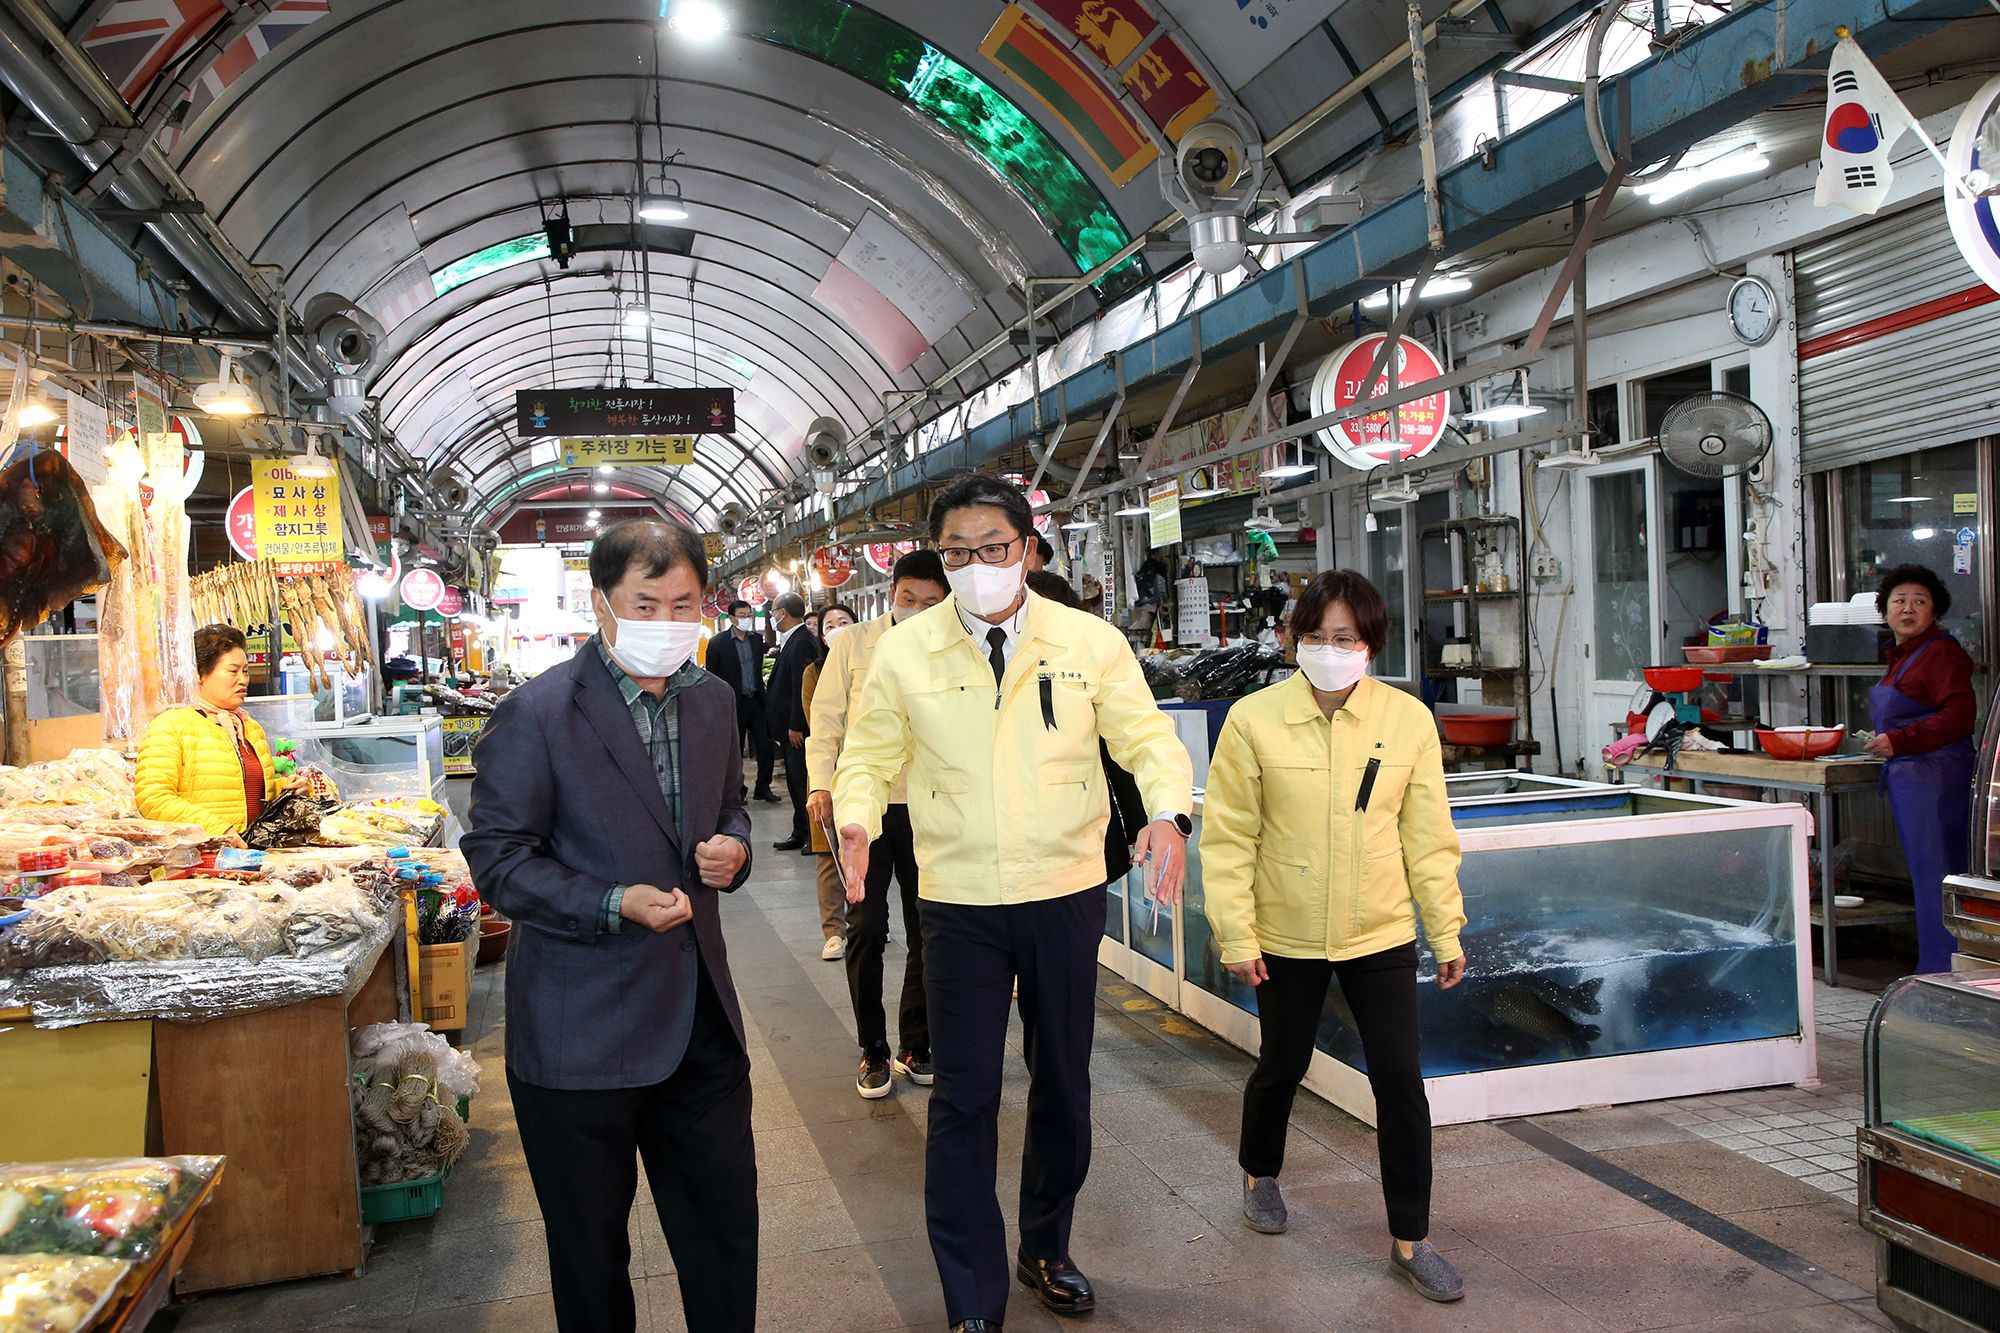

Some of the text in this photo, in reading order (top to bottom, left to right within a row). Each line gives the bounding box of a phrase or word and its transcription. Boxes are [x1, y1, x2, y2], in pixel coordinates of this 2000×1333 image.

[569, 398, 602, 413] 활기찬
[605, 398, 646, 411] 전통시장
[606, 414, 639, 426] 행복한
[641, 414, 684, 426] 동상시장
[580, 439, 687, 456] 주차장 가는 길
[274, 522, 330, 537] 함지그릇
